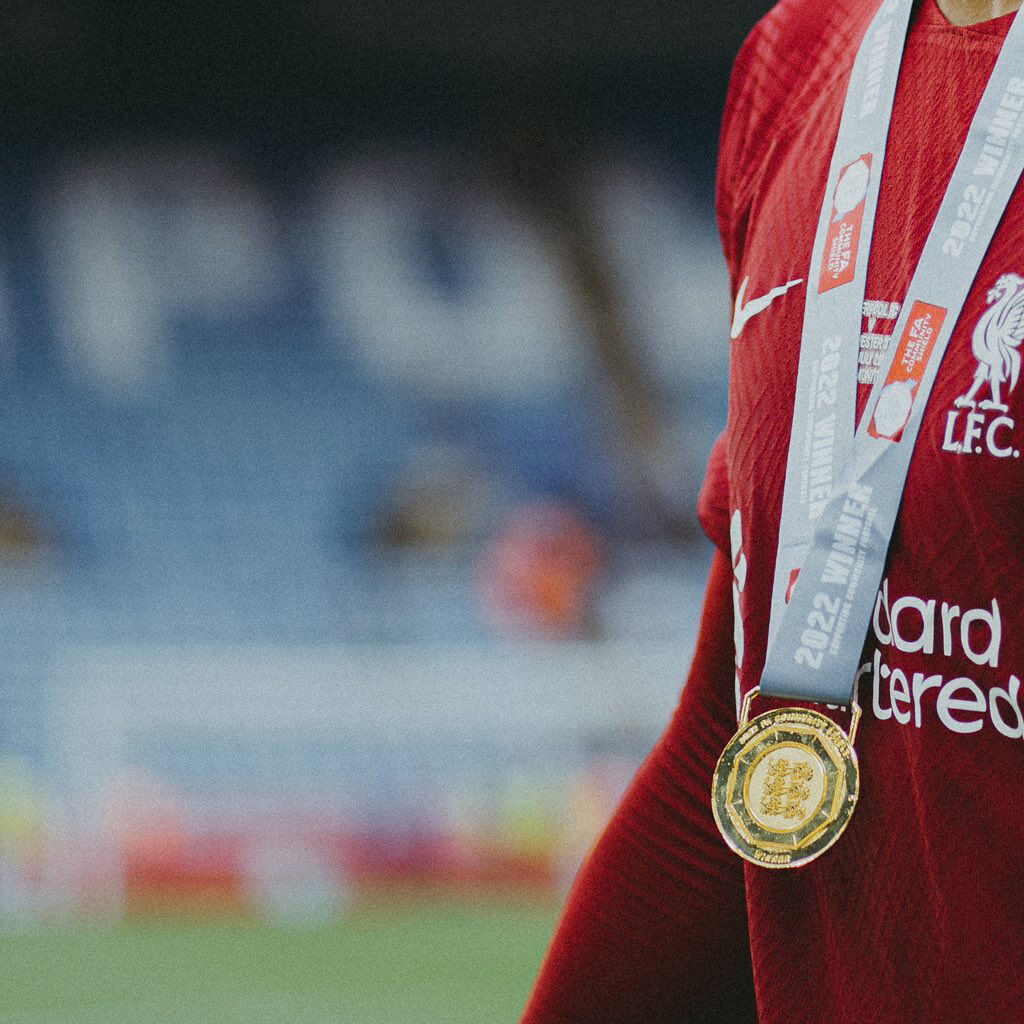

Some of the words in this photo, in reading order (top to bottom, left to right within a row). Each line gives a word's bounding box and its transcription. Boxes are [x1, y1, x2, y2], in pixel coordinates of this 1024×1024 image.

[843, 224, 853, 249] THE
[941, 183, 985, 257] 2022
[839, 250, 850, 272] FA
[902, 341, 916, 365] THE
[909, 318, 924, 338] FA
[907, 313, 932, 372] COMMUNITY
[916, 328, 933, 362] SHIELD
[816, 336, 840, 409] 2022
[793, 591, 841, 669] 2022
[820, 481, 873, 584] WINNER
